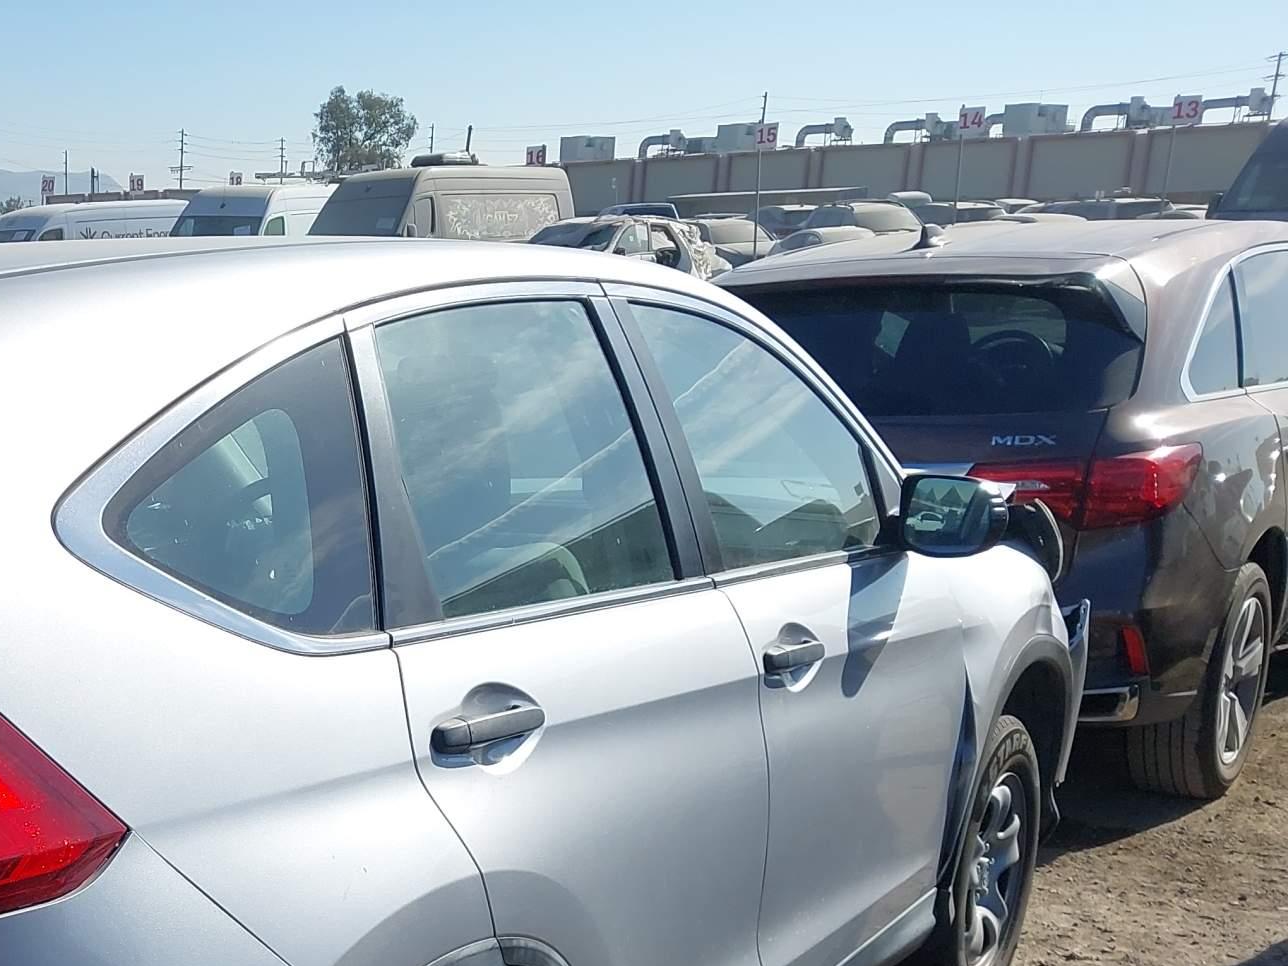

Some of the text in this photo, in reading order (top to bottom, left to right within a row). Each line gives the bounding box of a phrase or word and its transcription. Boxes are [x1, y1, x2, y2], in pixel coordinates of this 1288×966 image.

[1173, 100, 1199, 119] 13
[959, 111, 983, 129] 14
[756, 127, 777, 144] 15
[526, 149, 546, 165] 16
[41, 180, 54, 192] 20
[130, 178, 144, 191] 19
[992, 434, 1057, 446] MDX
